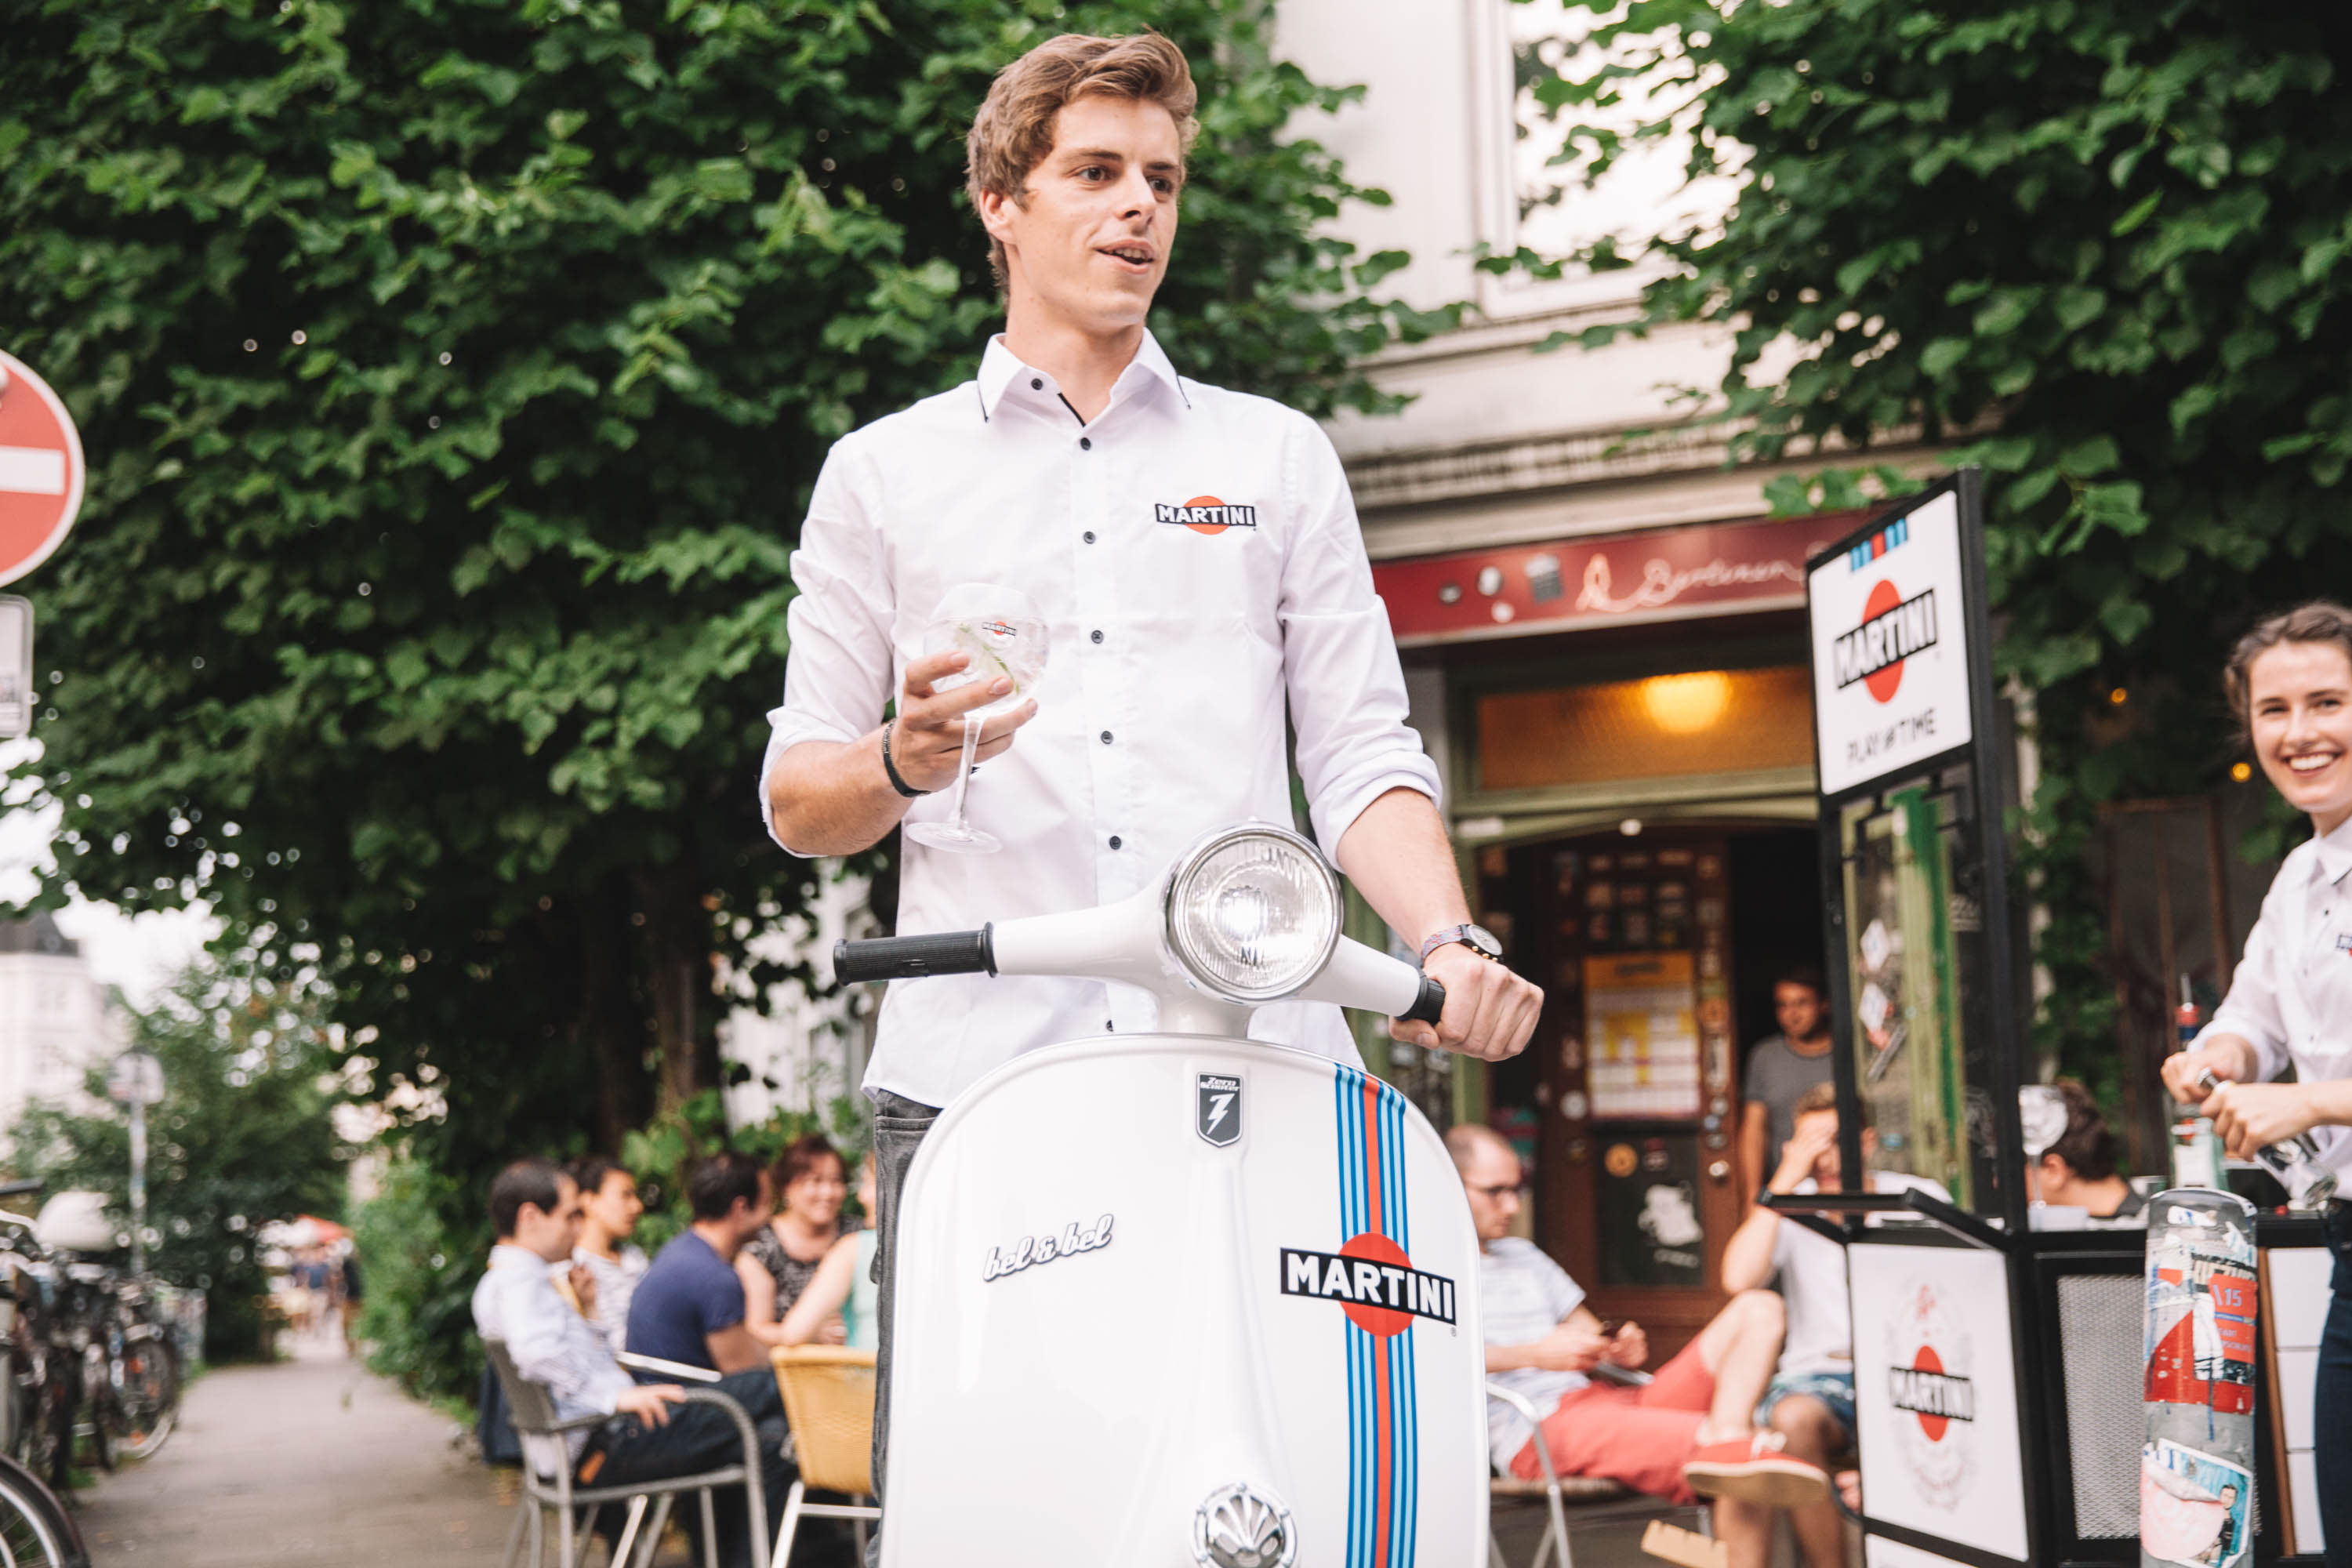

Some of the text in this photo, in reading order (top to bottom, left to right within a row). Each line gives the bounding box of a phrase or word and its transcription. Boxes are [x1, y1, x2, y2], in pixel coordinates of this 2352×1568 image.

[1158, 505, 1254, 524] MARTINI
[1836, 592, 1936, 685] MARTINI
[1897, 707, 1936, 745] TIME
[1287, 1253, 1454, 1320] MARTINI
[1890, 1370, 1973, 1420] MARTINI
